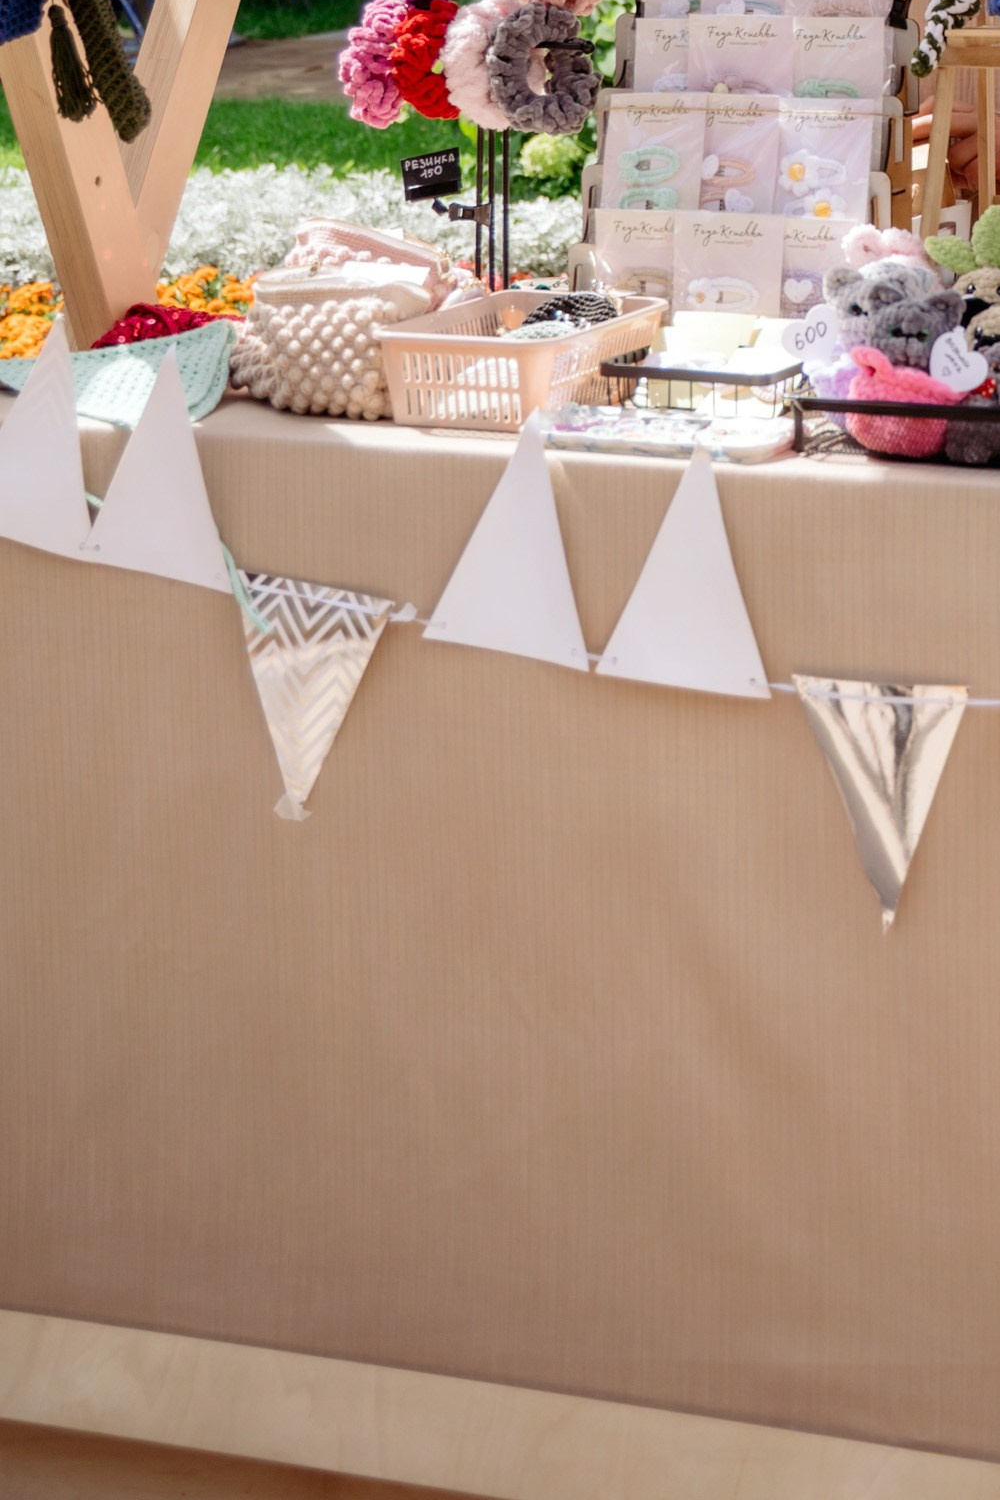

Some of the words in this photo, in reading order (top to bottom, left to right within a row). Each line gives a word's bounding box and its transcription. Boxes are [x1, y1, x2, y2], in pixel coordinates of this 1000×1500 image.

[404, 153, 456, 171] РЕЗИНКА
[420, 165, 443, 178] 150
[794, 321, 828, 351] 600
